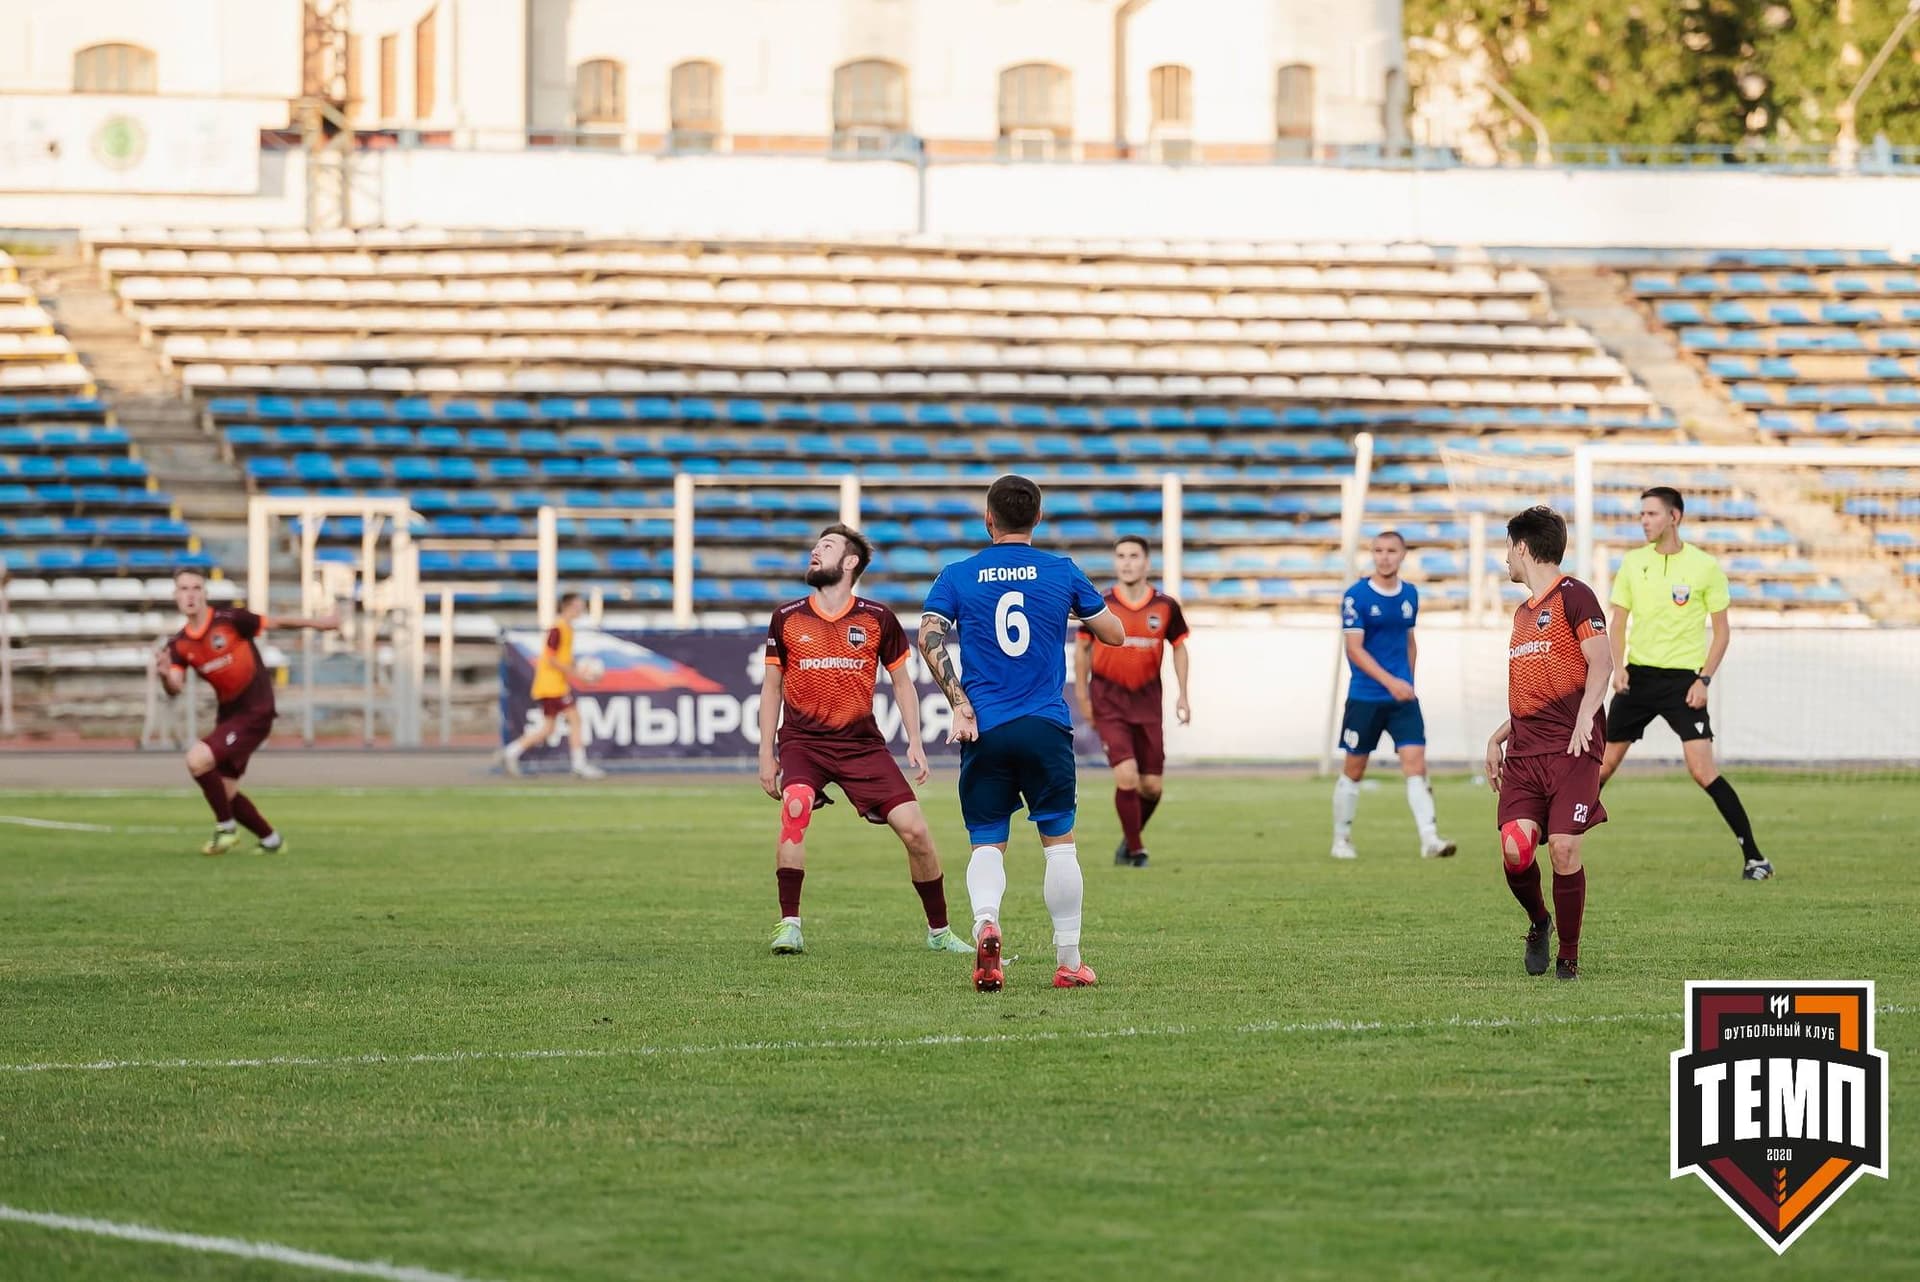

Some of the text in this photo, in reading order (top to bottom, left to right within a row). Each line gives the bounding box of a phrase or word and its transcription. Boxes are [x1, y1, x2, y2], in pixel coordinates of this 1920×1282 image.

[978, 566, 1038, 583] ЛЕОНОВ
[994, 590, 1031, 658] 6
[1573, 803, 1588, 823] 23
